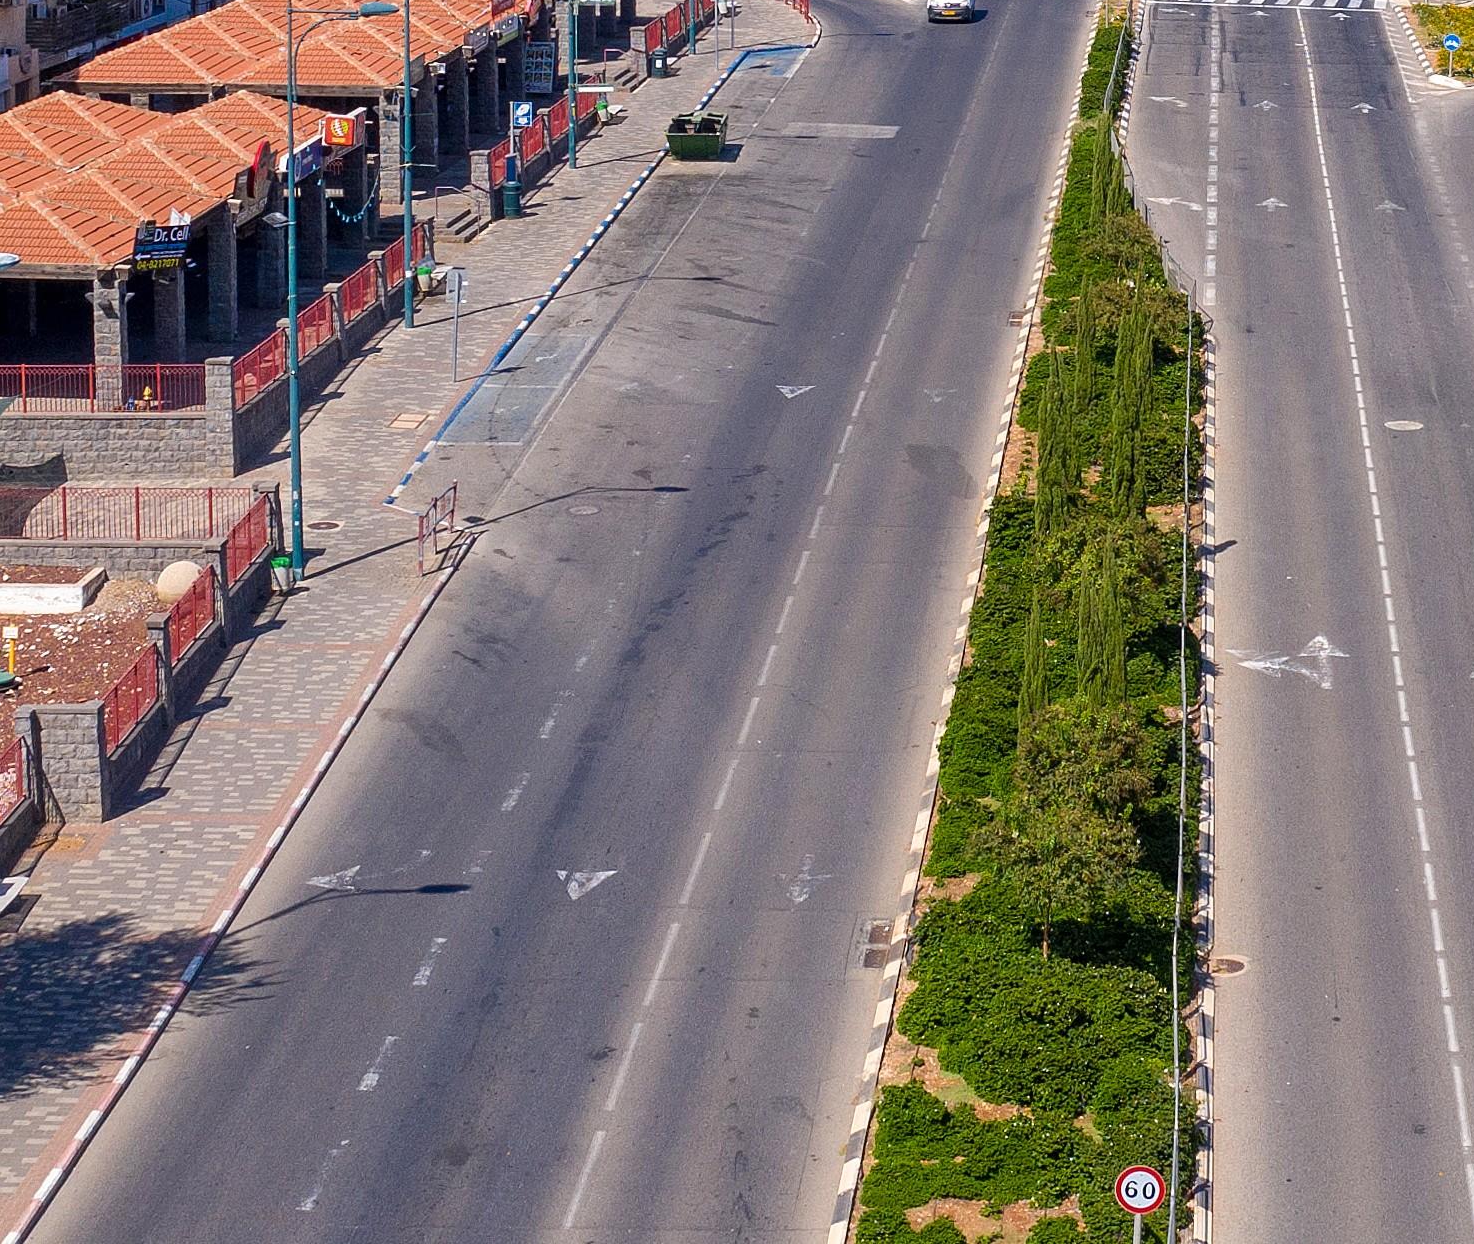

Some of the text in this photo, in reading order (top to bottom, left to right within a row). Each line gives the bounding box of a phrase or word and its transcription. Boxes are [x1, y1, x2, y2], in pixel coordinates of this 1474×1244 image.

[154, 226, 190, 242] Dr. Cell
[1125, 1181, 1156, 1200] 60
